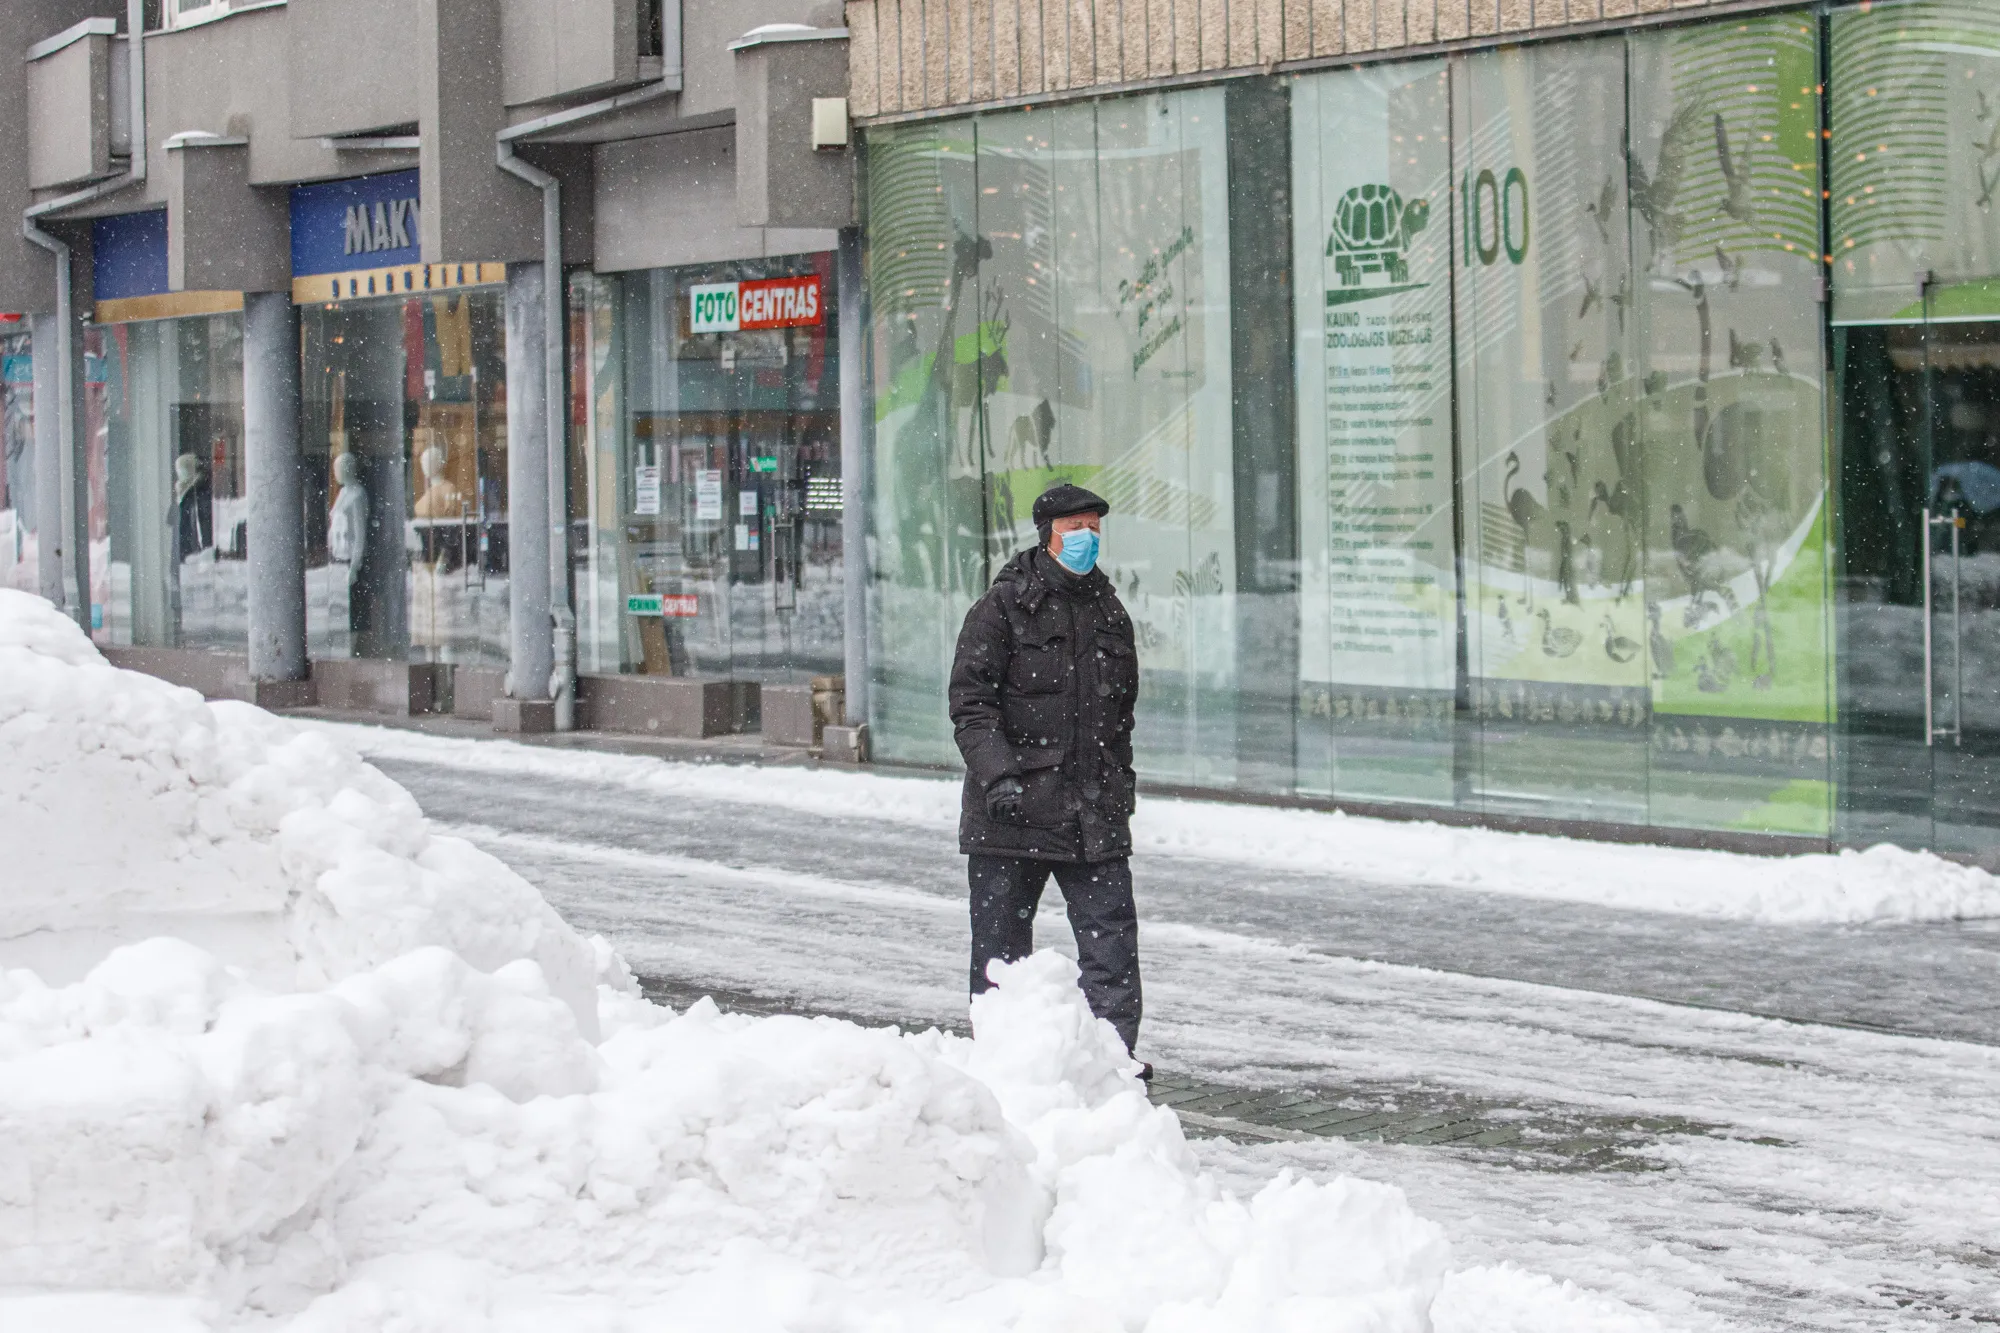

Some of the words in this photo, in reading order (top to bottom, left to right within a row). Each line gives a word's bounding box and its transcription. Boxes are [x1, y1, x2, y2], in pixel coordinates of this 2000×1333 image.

[1460, 166, 1530, 268] 100
[695, 291, 736, 324] FOTO
[742, 284, 818, 323] CENTRAS
[1326, 312, 1360, 328] KAUNO
[1326, 331, 1385, 349] ZOOLOGIJOS
